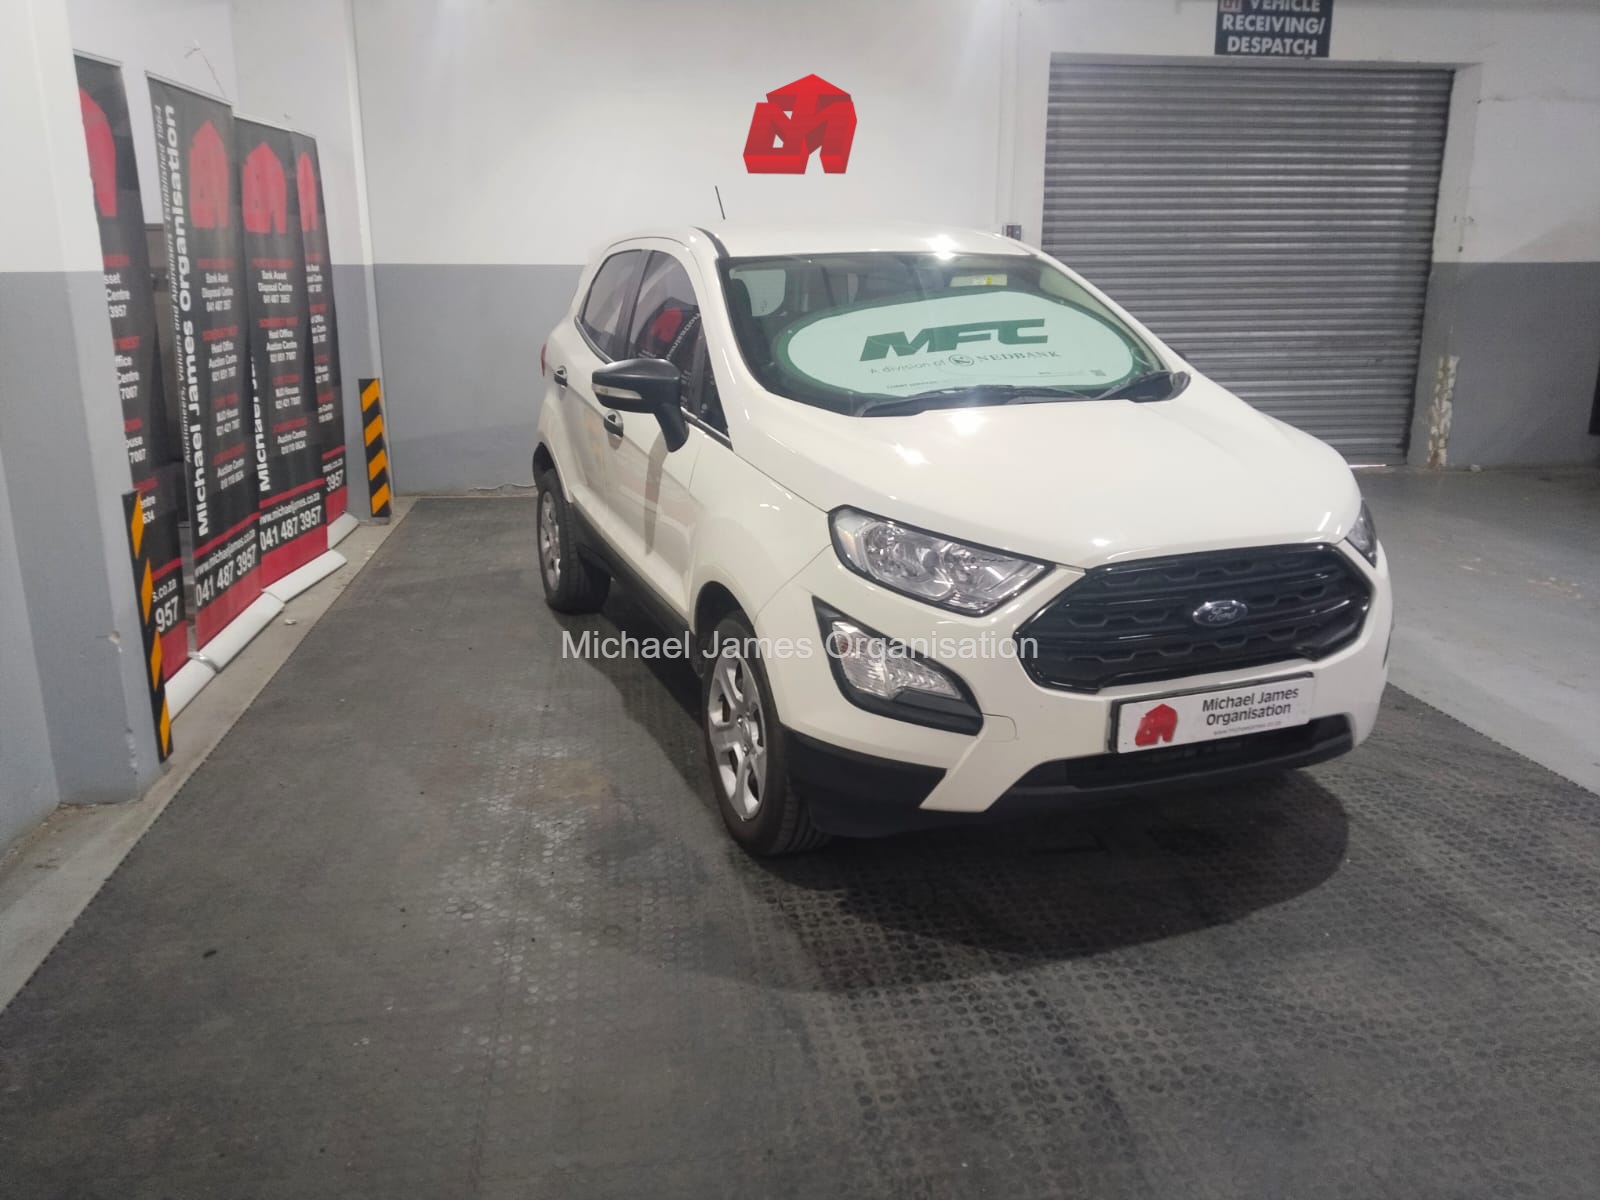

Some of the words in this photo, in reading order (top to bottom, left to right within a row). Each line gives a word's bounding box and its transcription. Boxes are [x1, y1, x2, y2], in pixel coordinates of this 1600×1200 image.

[1250, 0, 1320, 12] VEHICLE
[1227, 36, 1318, 55] DESPATCH
[165, 105, 192, 311] Organisation
[860, 318, 1048, 362] MFC
[976, 350, 1063, 363] NEDBANK
[182, 320, 200, 416] James
[190, 424, 209, 537] Michael
[260, 525, 279, 551] 041
[281, 516, 298, 539] 487
[299, 505, 321, 531] 3957
[196, 575, 214, 606] 041
[217, 560, 234, 590] 487
[236, 543, 257, 576] 3957
[155, 595, 178, 632] 957
[1208, 606, 1238, 622] Ford
[1202, 692, 1255, 712] Michael
[1258, 687, 1299, 704] James
[1206, 703, 1291, 726] Organisation
